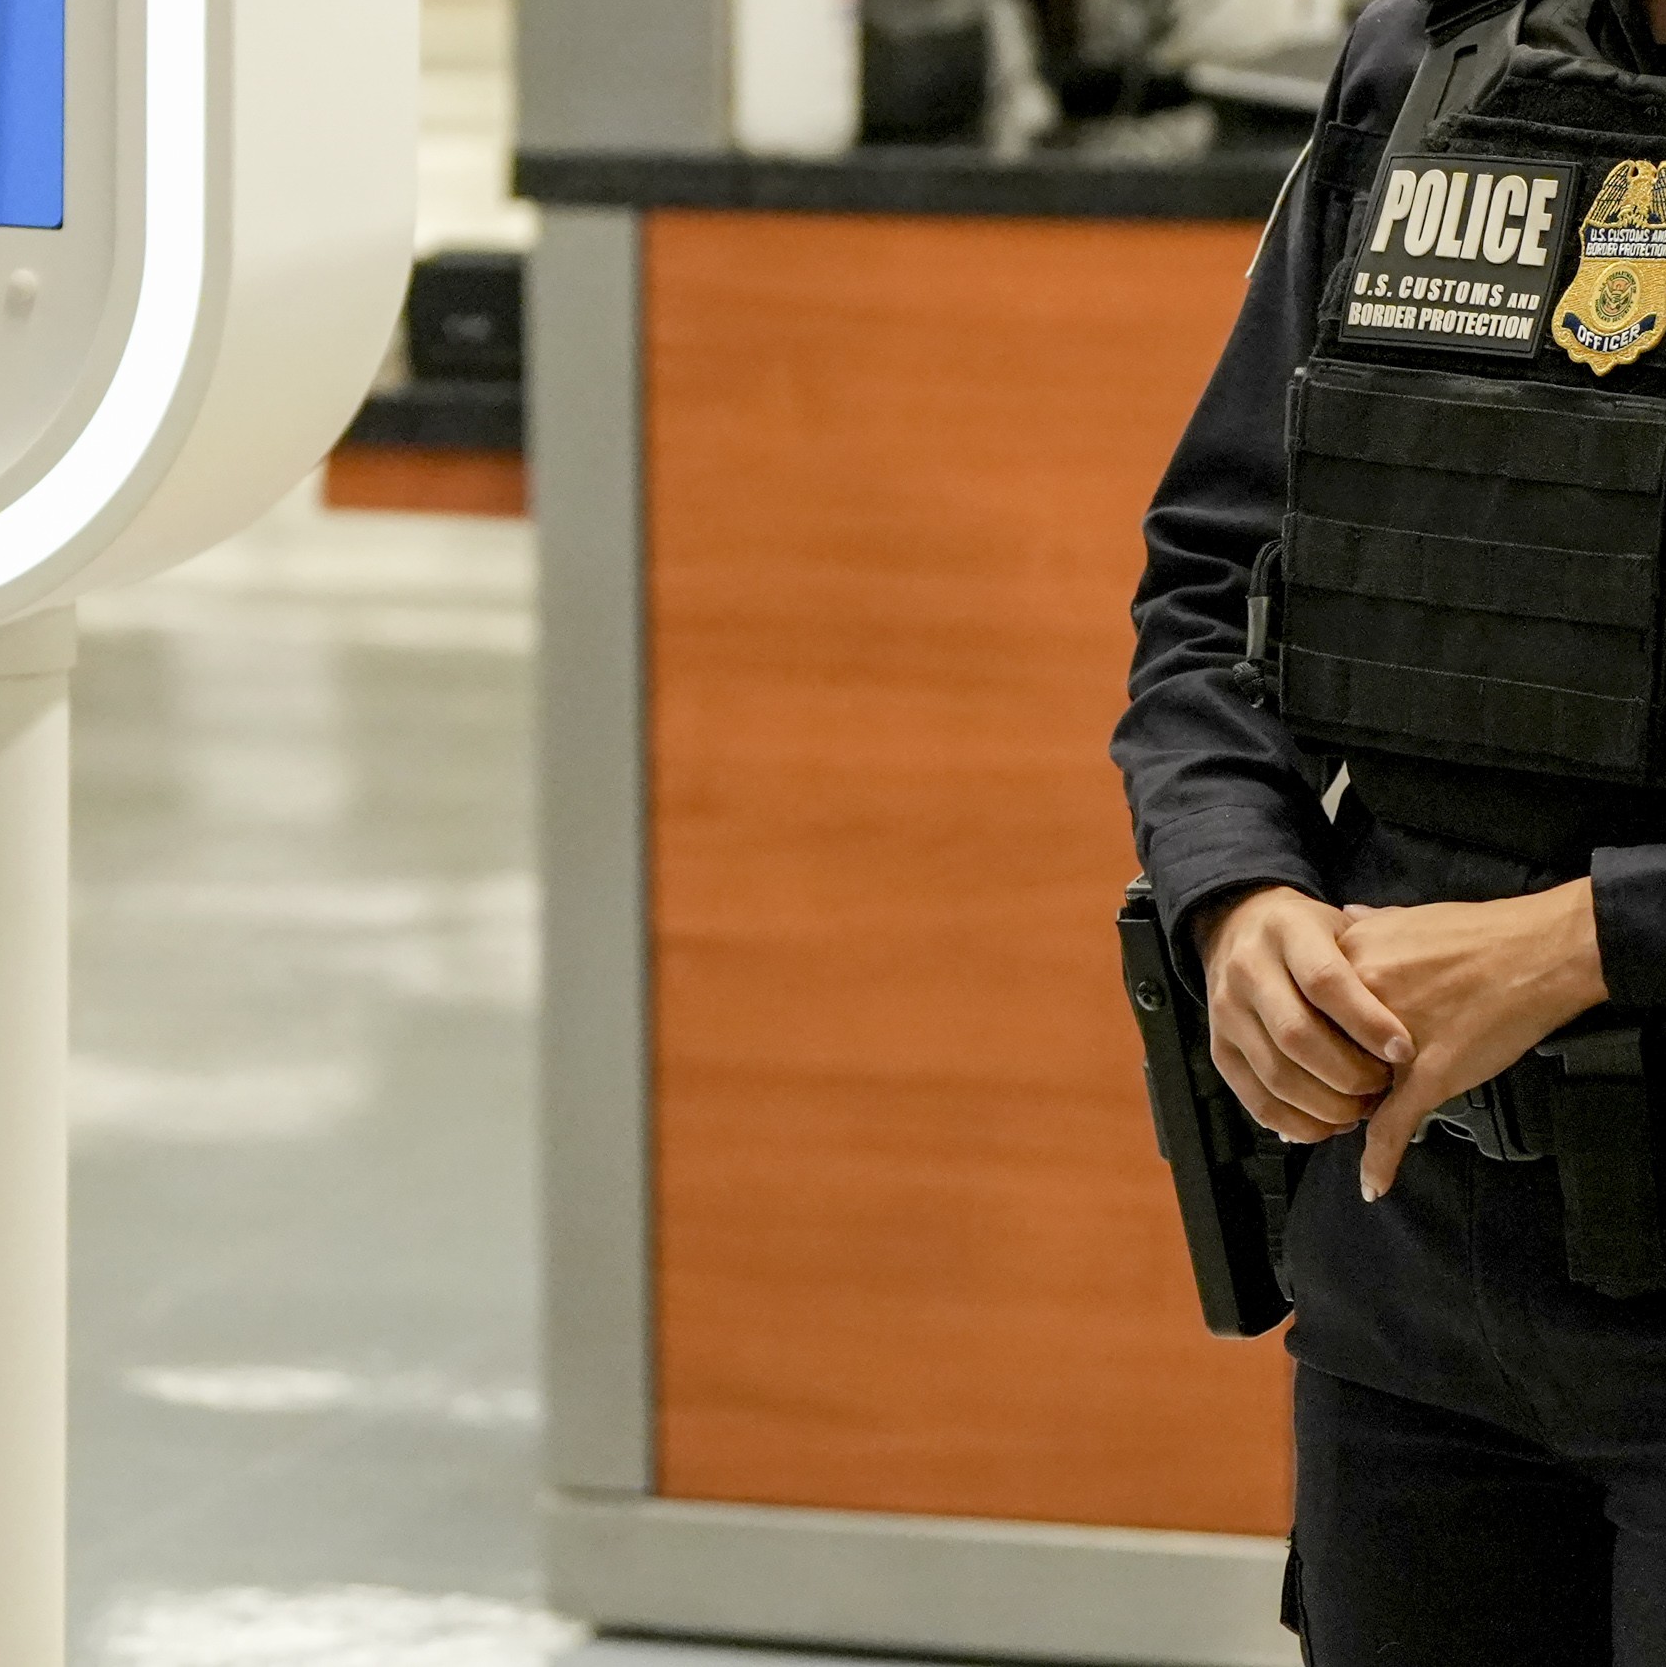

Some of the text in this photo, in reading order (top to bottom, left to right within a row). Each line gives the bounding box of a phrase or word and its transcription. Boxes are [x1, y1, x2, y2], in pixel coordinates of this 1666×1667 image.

[1370, 169, 1559, 267] POLICE
[1585, 242, 1618, 256] BORDER
[1608, 228, 1650, 243] CUSTOMS
[1353, 272, 1541, 311] U.S. CUSTOMS AND
[1347, 301, 1534, 340] BORDER PROTECTION
[1577, 323, 1642, 352] OFFICER
